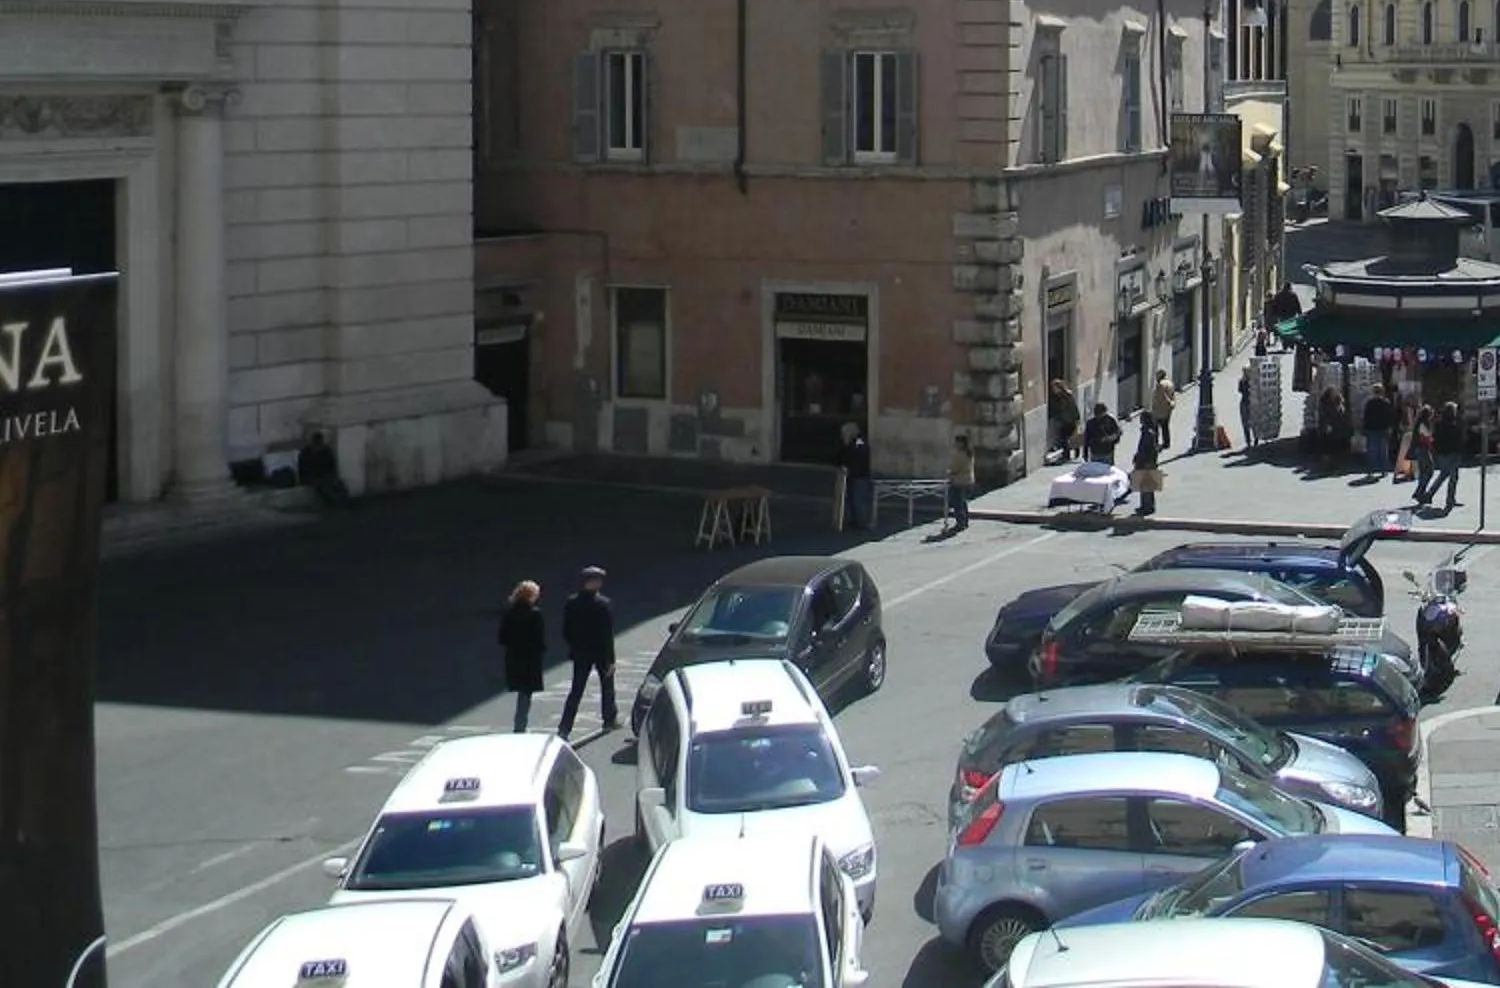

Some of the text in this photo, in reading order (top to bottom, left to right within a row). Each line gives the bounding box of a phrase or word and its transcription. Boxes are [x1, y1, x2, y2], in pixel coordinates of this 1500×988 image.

[0, 405, 81, 444] IVELA
[447, 778, 480, 790] TAXI
[705, 885, 741, 898] TAXI
[304, 961, 344, 977] TAXI
